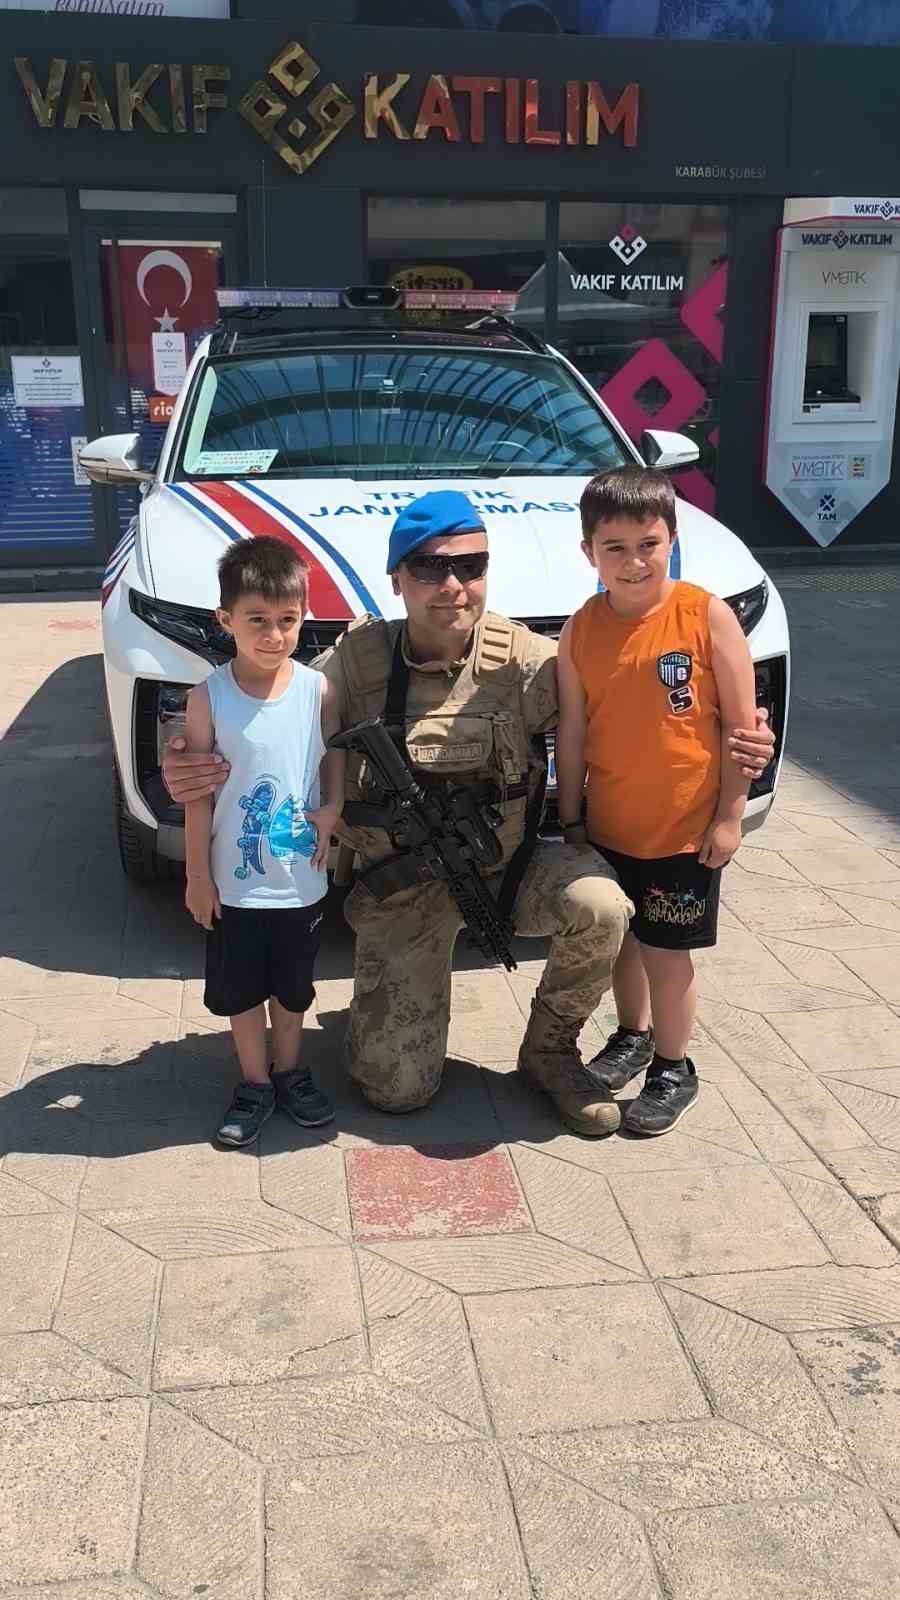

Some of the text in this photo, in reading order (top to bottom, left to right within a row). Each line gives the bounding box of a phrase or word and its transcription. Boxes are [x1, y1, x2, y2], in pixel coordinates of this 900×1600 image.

[14, 57, 640, 147] VAKIF KATILIM
[675, 164, 727, 178] KARABÜK
[854, 204, 880, 214] VAKIF
[801, 233, 893, 246] VAKIF KATILIM
[570, 274, 684, 291] VAKIF KATILIM
[364, 490, 513, 500] TRİK
[309, 503, 581, 517] JANMAS
[817, 513, 837, 521] TAM
